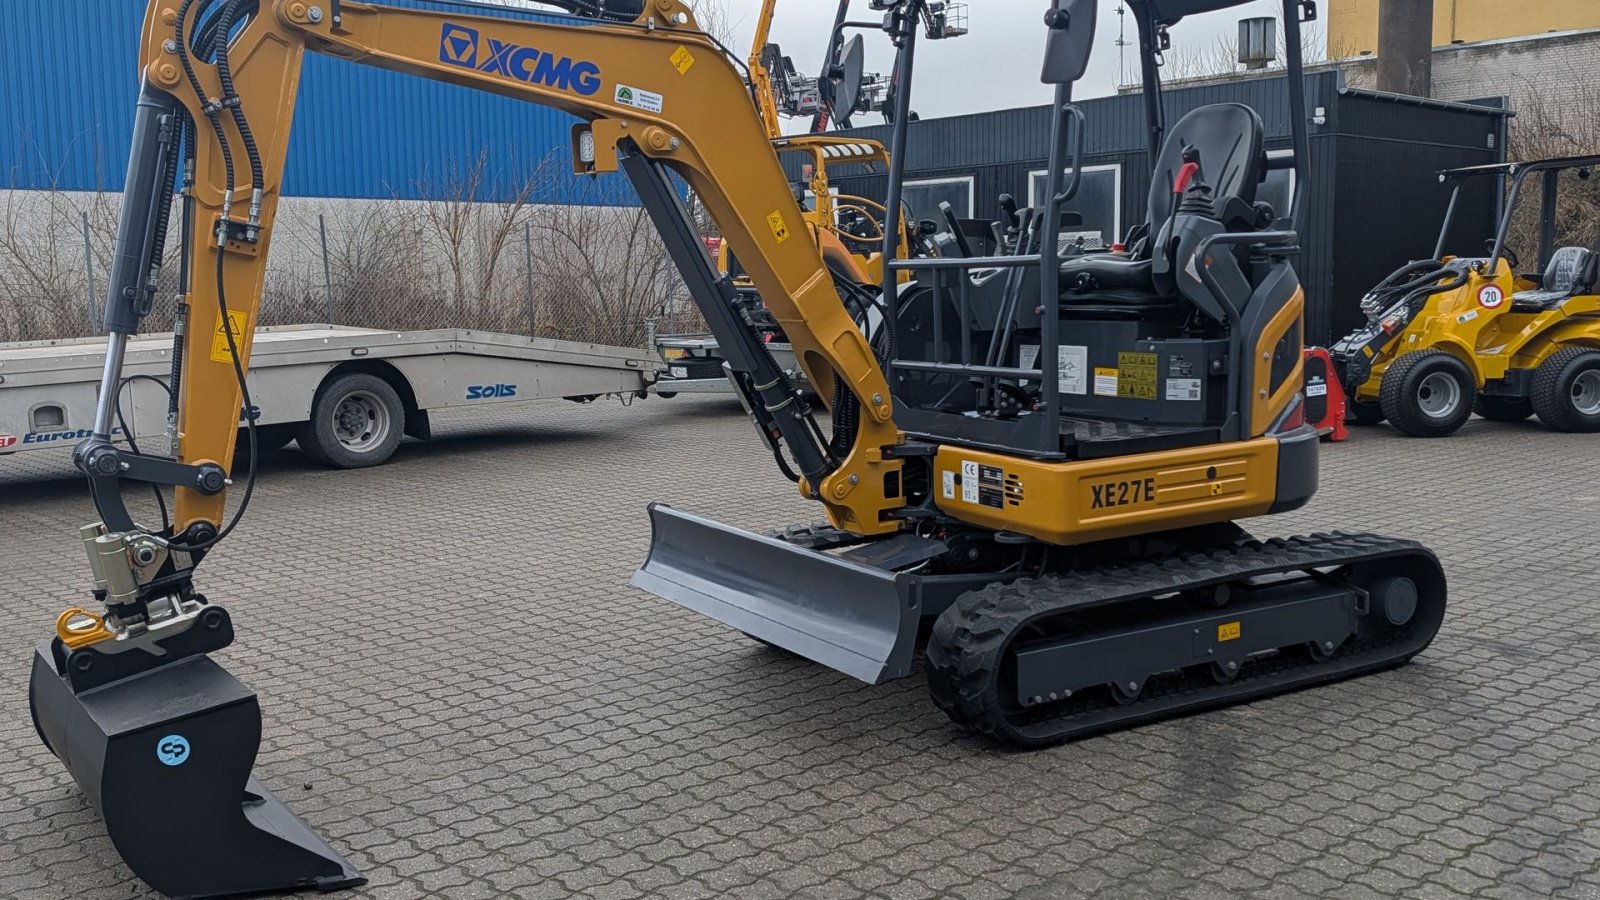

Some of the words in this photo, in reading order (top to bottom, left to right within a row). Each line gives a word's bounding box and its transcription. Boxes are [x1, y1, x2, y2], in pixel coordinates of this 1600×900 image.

[476, 38, 601, 96] XCMG
[1484, 291, 1497, 303] 20
[466, 384, 517, 399] Solis
[22, 427, 122, 444] Eurotrc
[1091, 478, 1155, 509] XE27E
